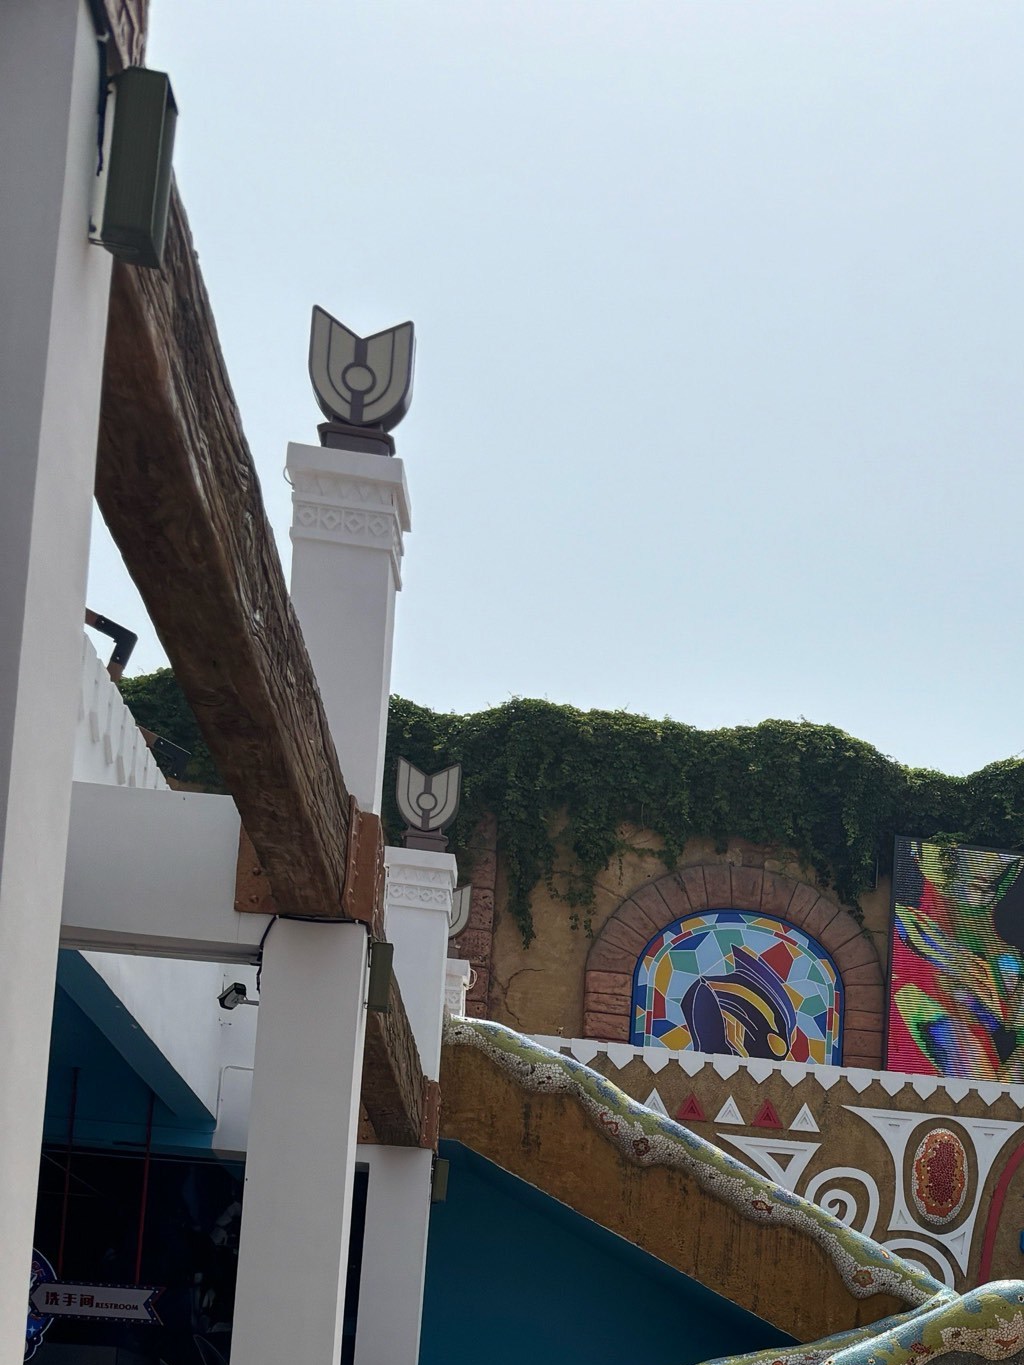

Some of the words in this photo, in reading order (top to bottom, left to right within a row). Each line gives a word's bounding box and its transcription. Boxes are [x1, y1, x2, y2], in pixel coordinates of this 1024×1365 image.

[45, 1291, 94, 1308] 洗手间
[95, 1302, 139, 1311] RESTROOM
